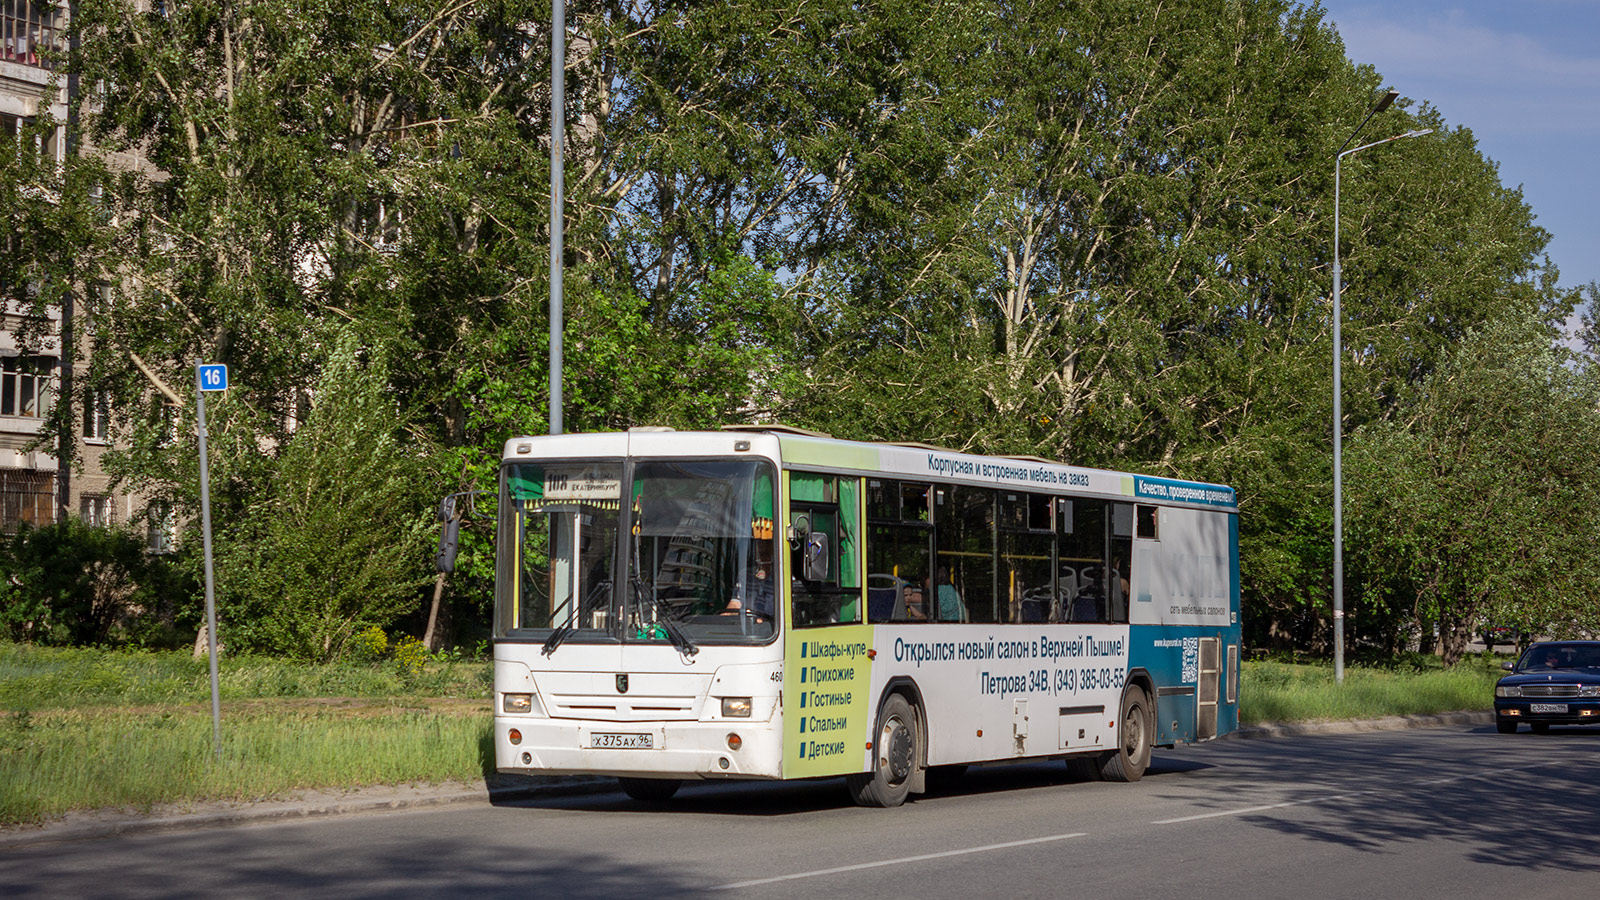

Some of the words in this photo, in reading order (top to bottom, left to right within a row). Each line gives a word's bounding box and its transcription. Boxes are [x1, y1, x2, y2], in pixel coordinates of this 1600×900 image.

[204, 368, 220, 386] 16
[928, 453, 974, 476] Корпусная
[975, 464, 981, 476] и
[982, 464, 1028, 482] встроенная
[1029, 466, 1057, 484] мебель
[1058, 472, 1068, 484] на
[1068, 473, 1089, 486] заказ
[548, 474, 568, 492] 108
[1138, 479, 1168, 499] Качество,
[1208, 606, 1225, 616] салонов
[810, 641, 866, 661] Шкафы-купе
[894, 637, 954, 668] Открылся
[958, 635, 994, 660] новый
[997, 639, 1030, 659] салон
[1032, 640, 1038, 658] в
[1041, 634, 1084, 663] Верхней
[1086, 635, 1124, 657] Пышме!
[810, 666, 854, 687] Прихожие
[982, 672, 1026, 700] Петрова
[1053, 668, 1078, 696] (343)
[1080, 668, 1124, 690] 385-03-55
[810, 691, 852, 708] Гостиные
[810, 716, 847, 733] Спальни
[595, 735, 636, 746] Х375АХ
[639, 735, 649, 744] 96
[808, 741, 845, 760] Детские
